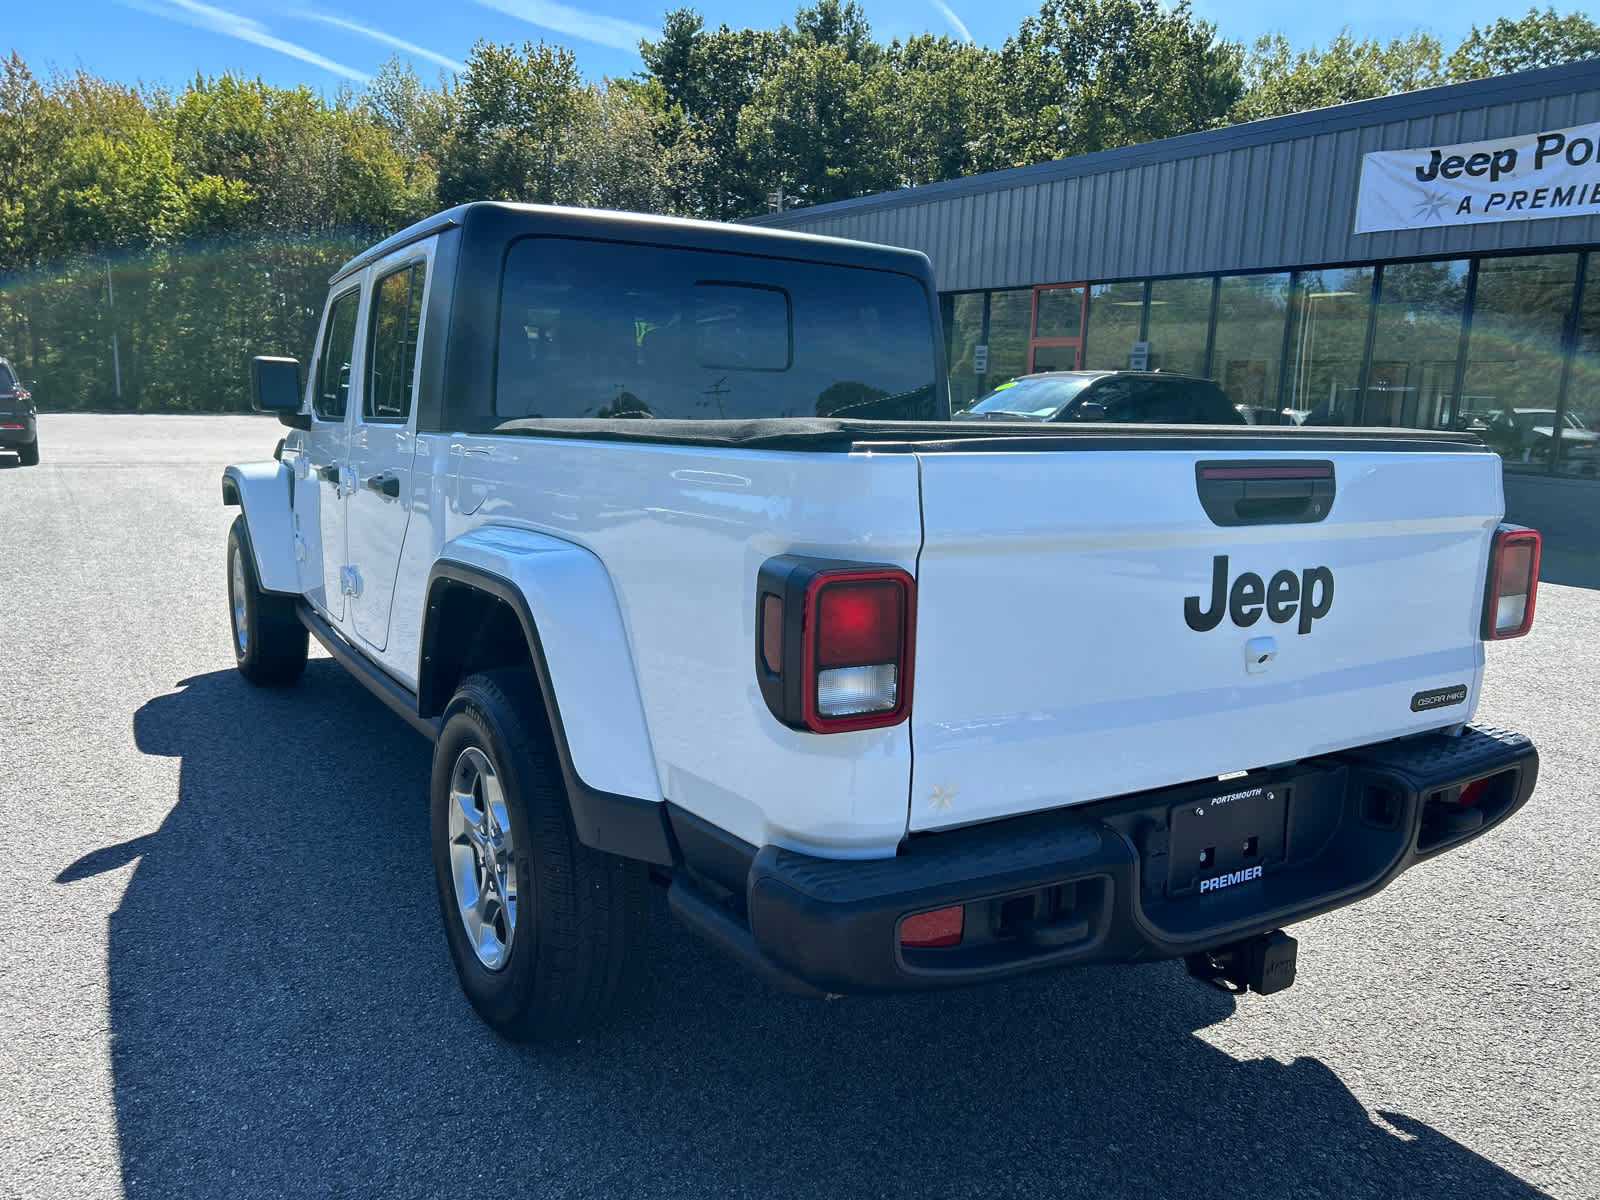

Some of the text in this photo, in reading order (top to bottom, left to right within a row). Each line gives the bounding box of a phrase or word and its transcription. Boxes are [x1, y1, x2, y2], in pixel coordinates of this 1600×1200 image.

[1416, 149, 1518, 182] Jeep
[1455, 195, 1472, 216] A
[1183, 554, 1335, 635] Jeep
[1211, 788, 1262, 806] PORTSMOUTH
[1200, 866, 1262, 893] PREMIER
